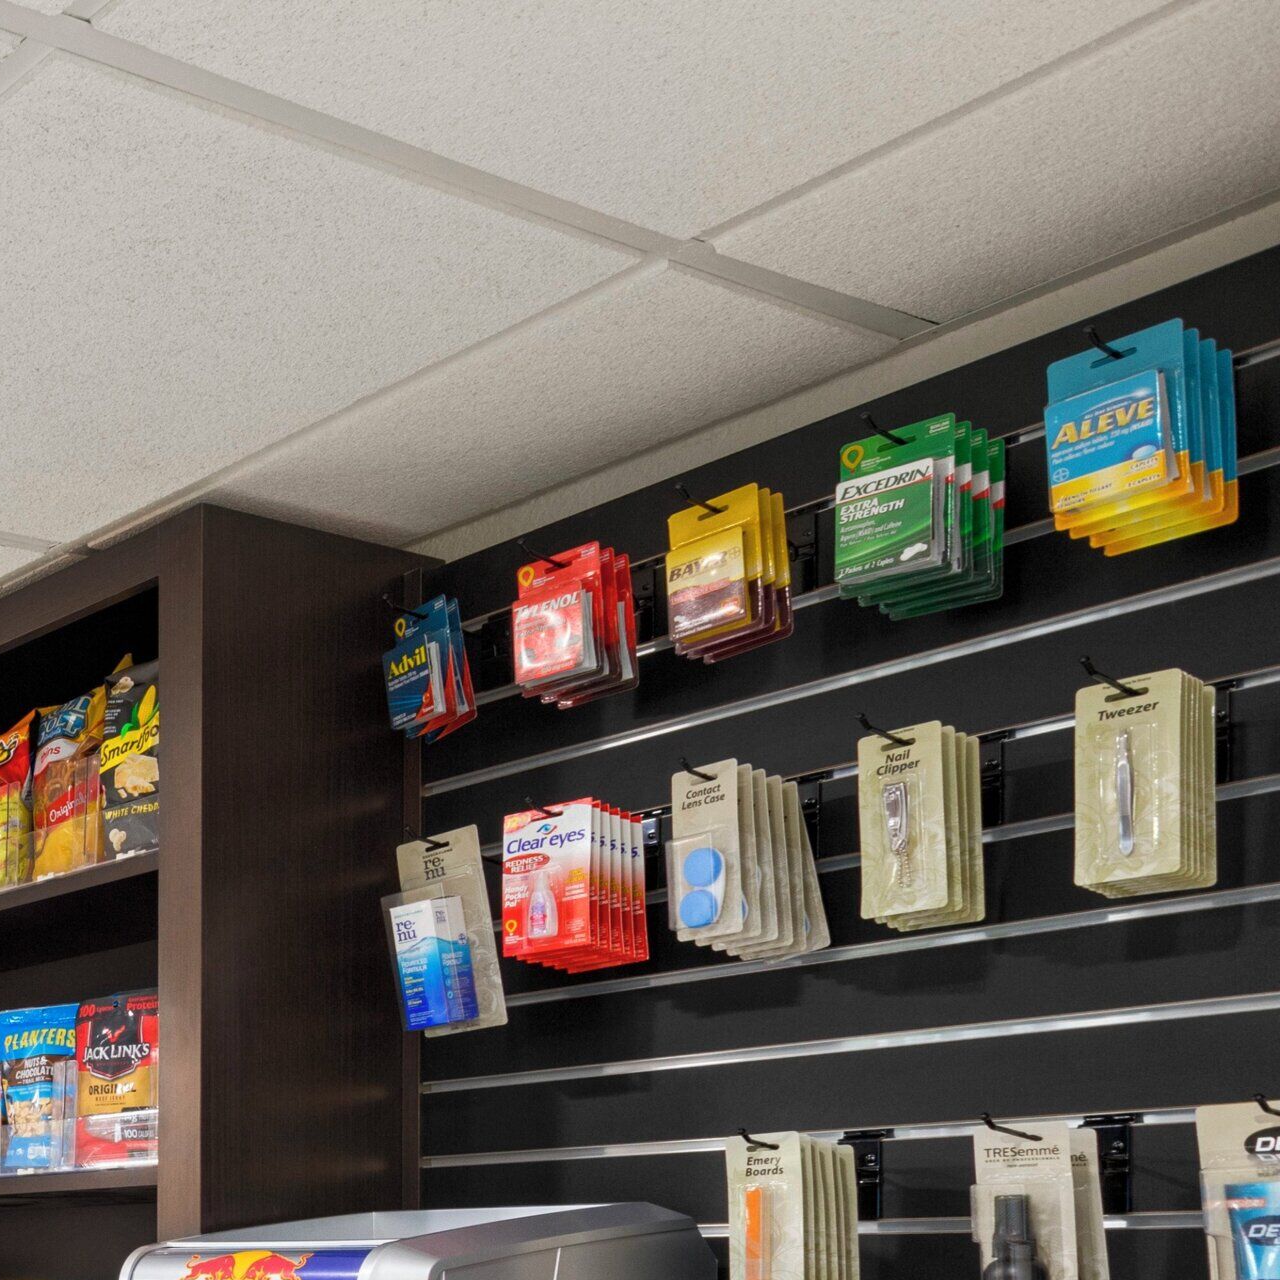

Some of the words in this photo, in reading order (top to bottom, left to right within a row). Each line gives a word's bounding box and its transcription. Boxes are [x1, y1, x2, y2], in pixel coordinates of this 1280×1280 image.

[1051, 398, 1157, 450] ALEVE
[842, 465, 930, 500] EXCEDRIN
[840, 498, 879, 516] EXTRA
[840, 498, 905, 525] STRENGTH
[389, 645, 427, 679] Advil
[1098, 700, 1159, 722] Tweezer
[886, 749, 911, 764] Nail
[876, 758, 921, 777] Clipper
[685, 784, 721, 800] Contact
[681, 799, 703, 811] Lens
[704, 794, 726, 804] Case
[507, 835, 545, 855] Clear
[549, 829, 586, 849] eyes
[425, 869, 446, 881] nu
[397, 929, 416, 942] nu
[4, 1028, 76, 1052] PLANTERS
[83, 1045, 109, 1061] JACK
[111, 1043, 150, 1061] LINK'S
[984, 1145, 1060, 1158] TRESemmé
[746, 1156, 781, 1168] Emery
[745, 1166, 784, 1177] Boards
